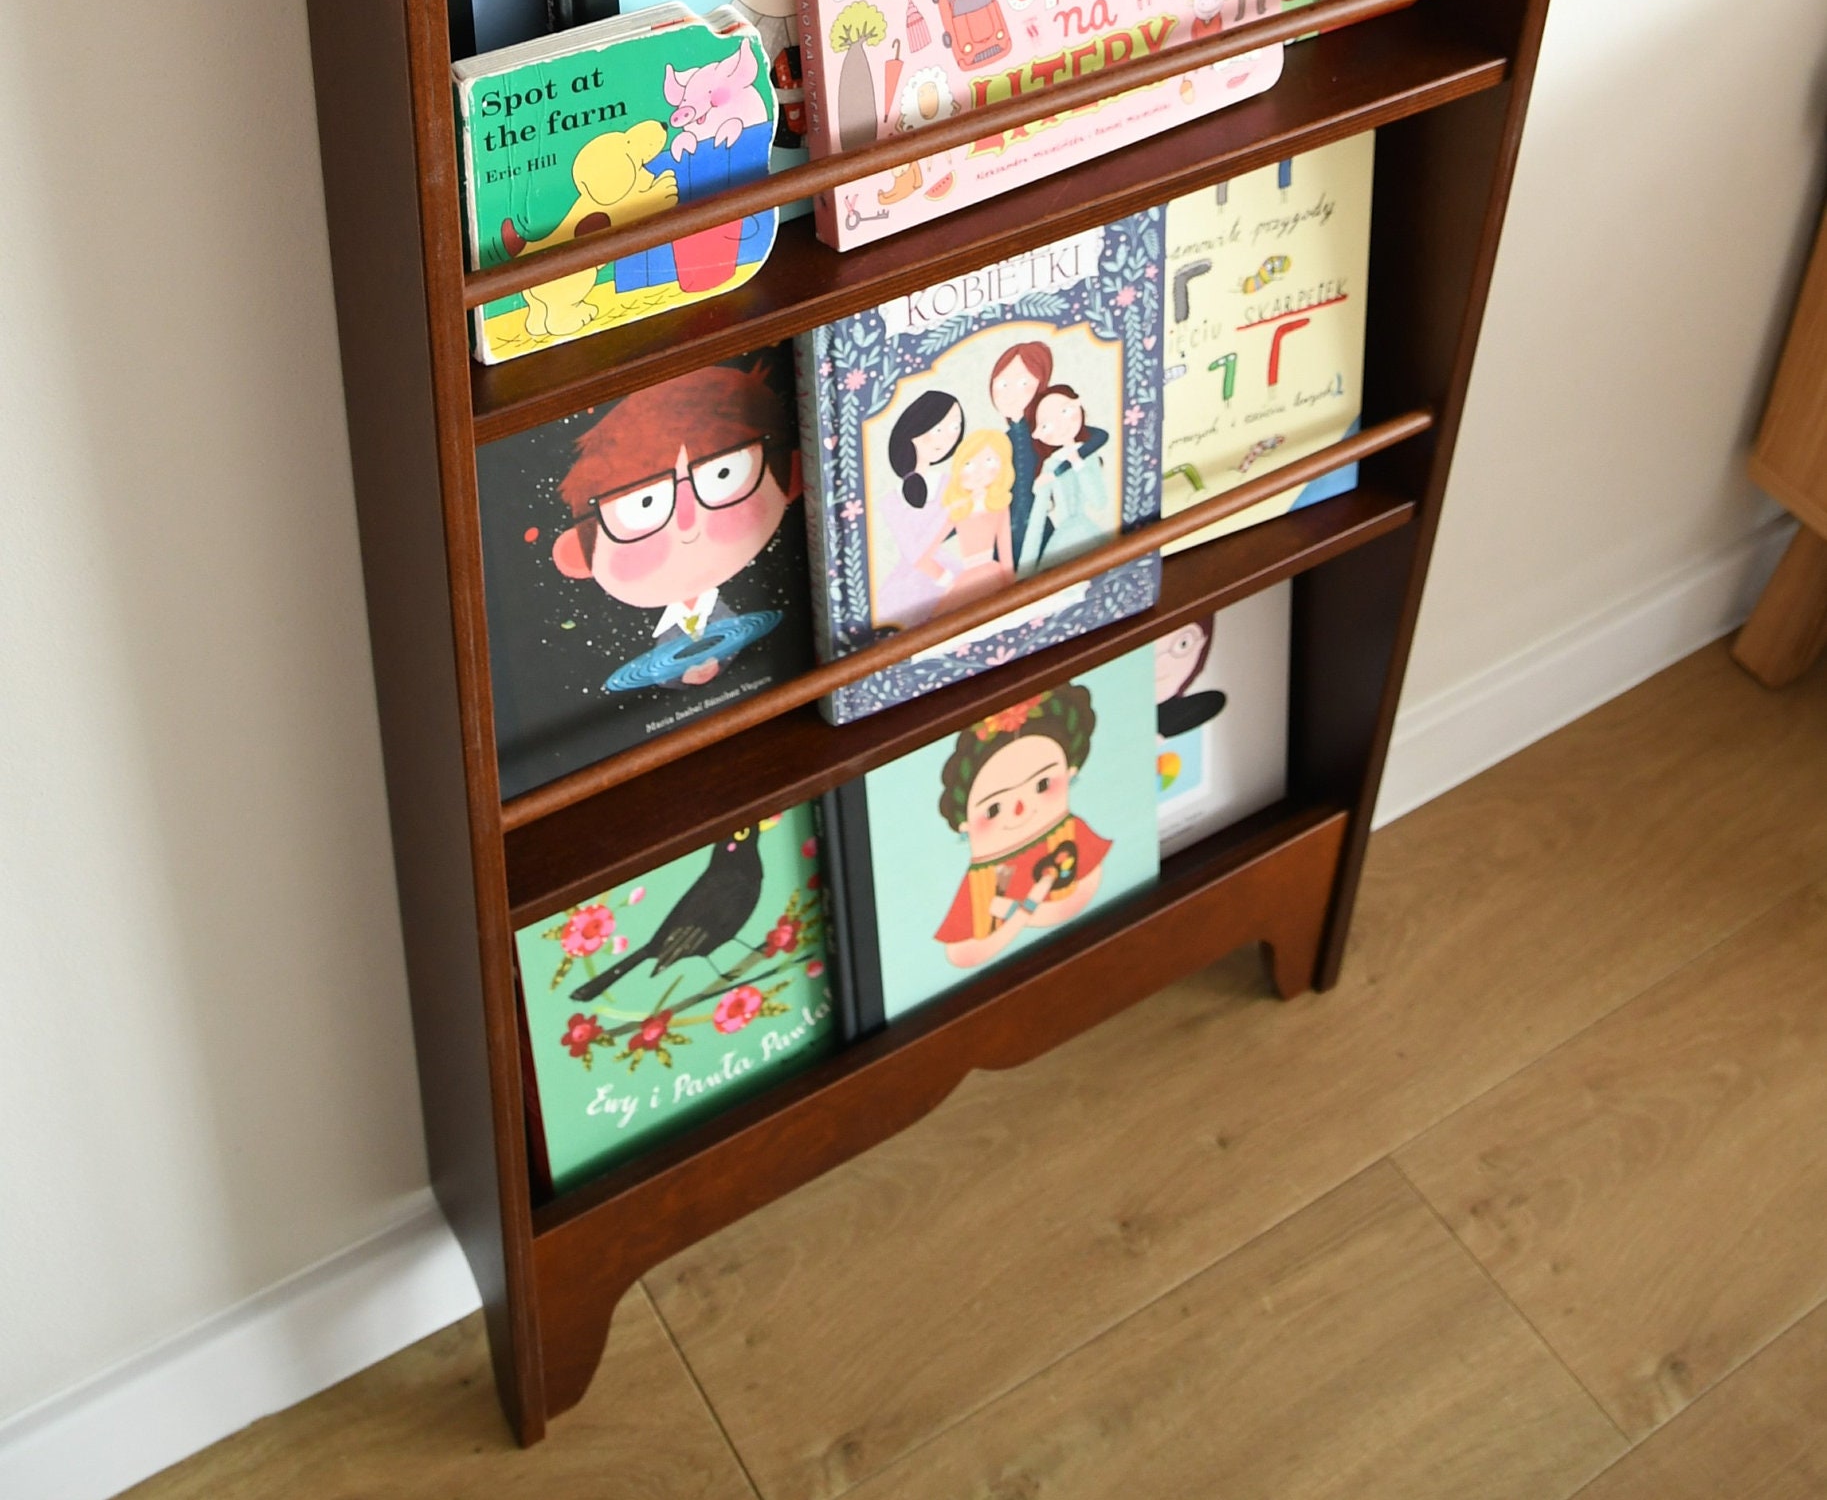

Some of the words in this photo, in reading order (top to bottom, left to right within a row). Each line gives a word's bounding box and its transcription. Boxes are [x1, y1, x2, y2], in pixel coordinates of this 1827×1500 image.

[803, 33, 814, 60] NA
[481, 79, 559, 118] Spot
[571, 67, 605, 94] at
[483, 123, 537, 152] the
[546, 100, 628, 136] farm
[485, 165, 522, 184] Eric
[527, 152, 558, 173] Hill
[907, 244, 1081, 327] KOBIETKI
[586, 1082, 639, 1129] Ewy
[650, 1086, 661, 1109] i
[673, 1049, 755, 1104] Pawła
